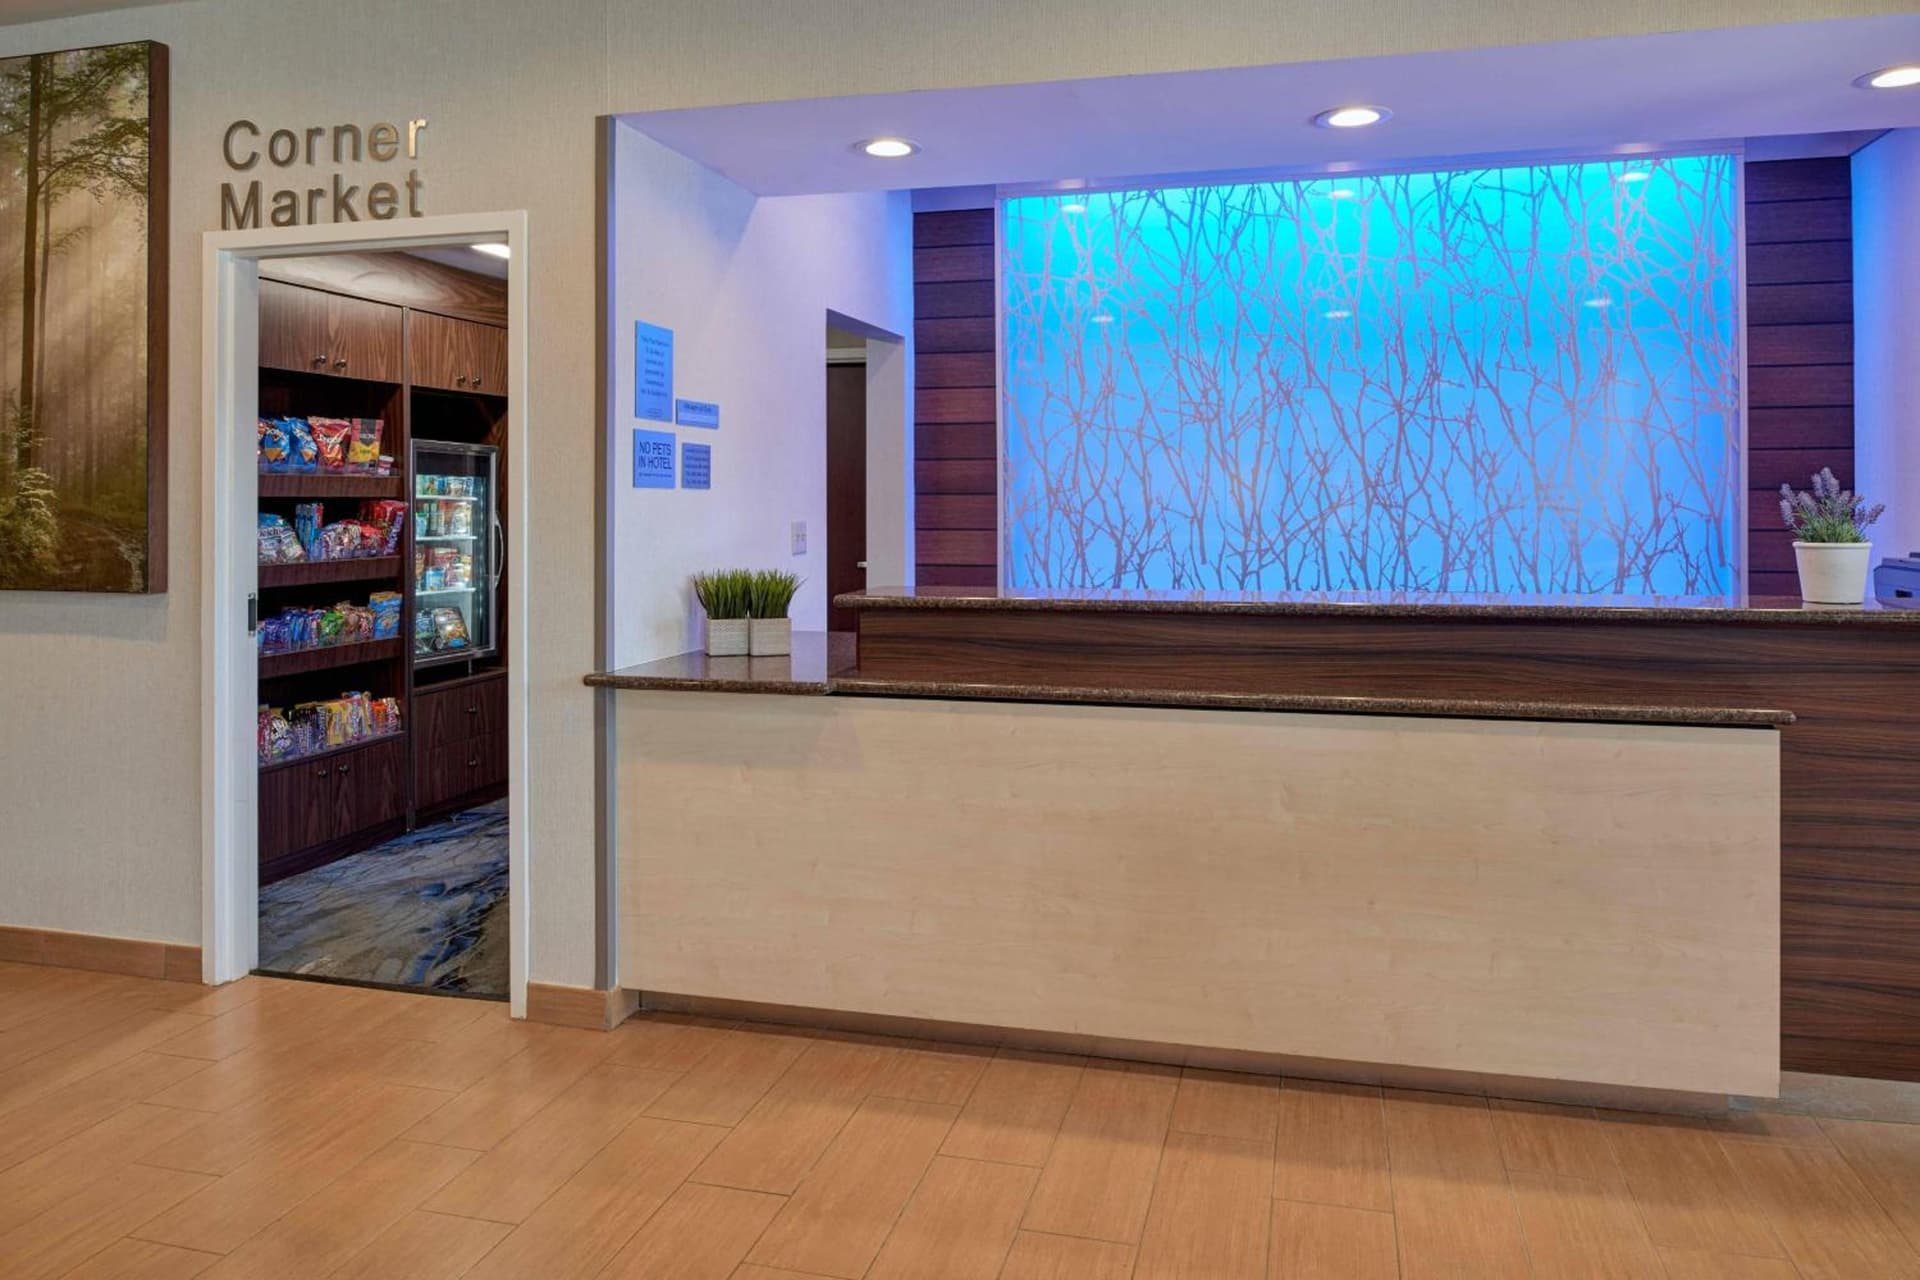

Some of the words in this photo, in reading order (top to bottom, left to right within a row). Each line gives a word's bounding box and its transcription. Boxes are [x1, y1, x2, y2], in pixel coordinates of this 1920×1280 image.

[223, 118, 428, 171] Corner
[220, 168, 424, 231] Market
[638, 456, 646, 468] IN
[648, 456, 673, 470] HOTEL
[639, 441, 651, 454] NO
[653, 442, 672, 456] PETS
